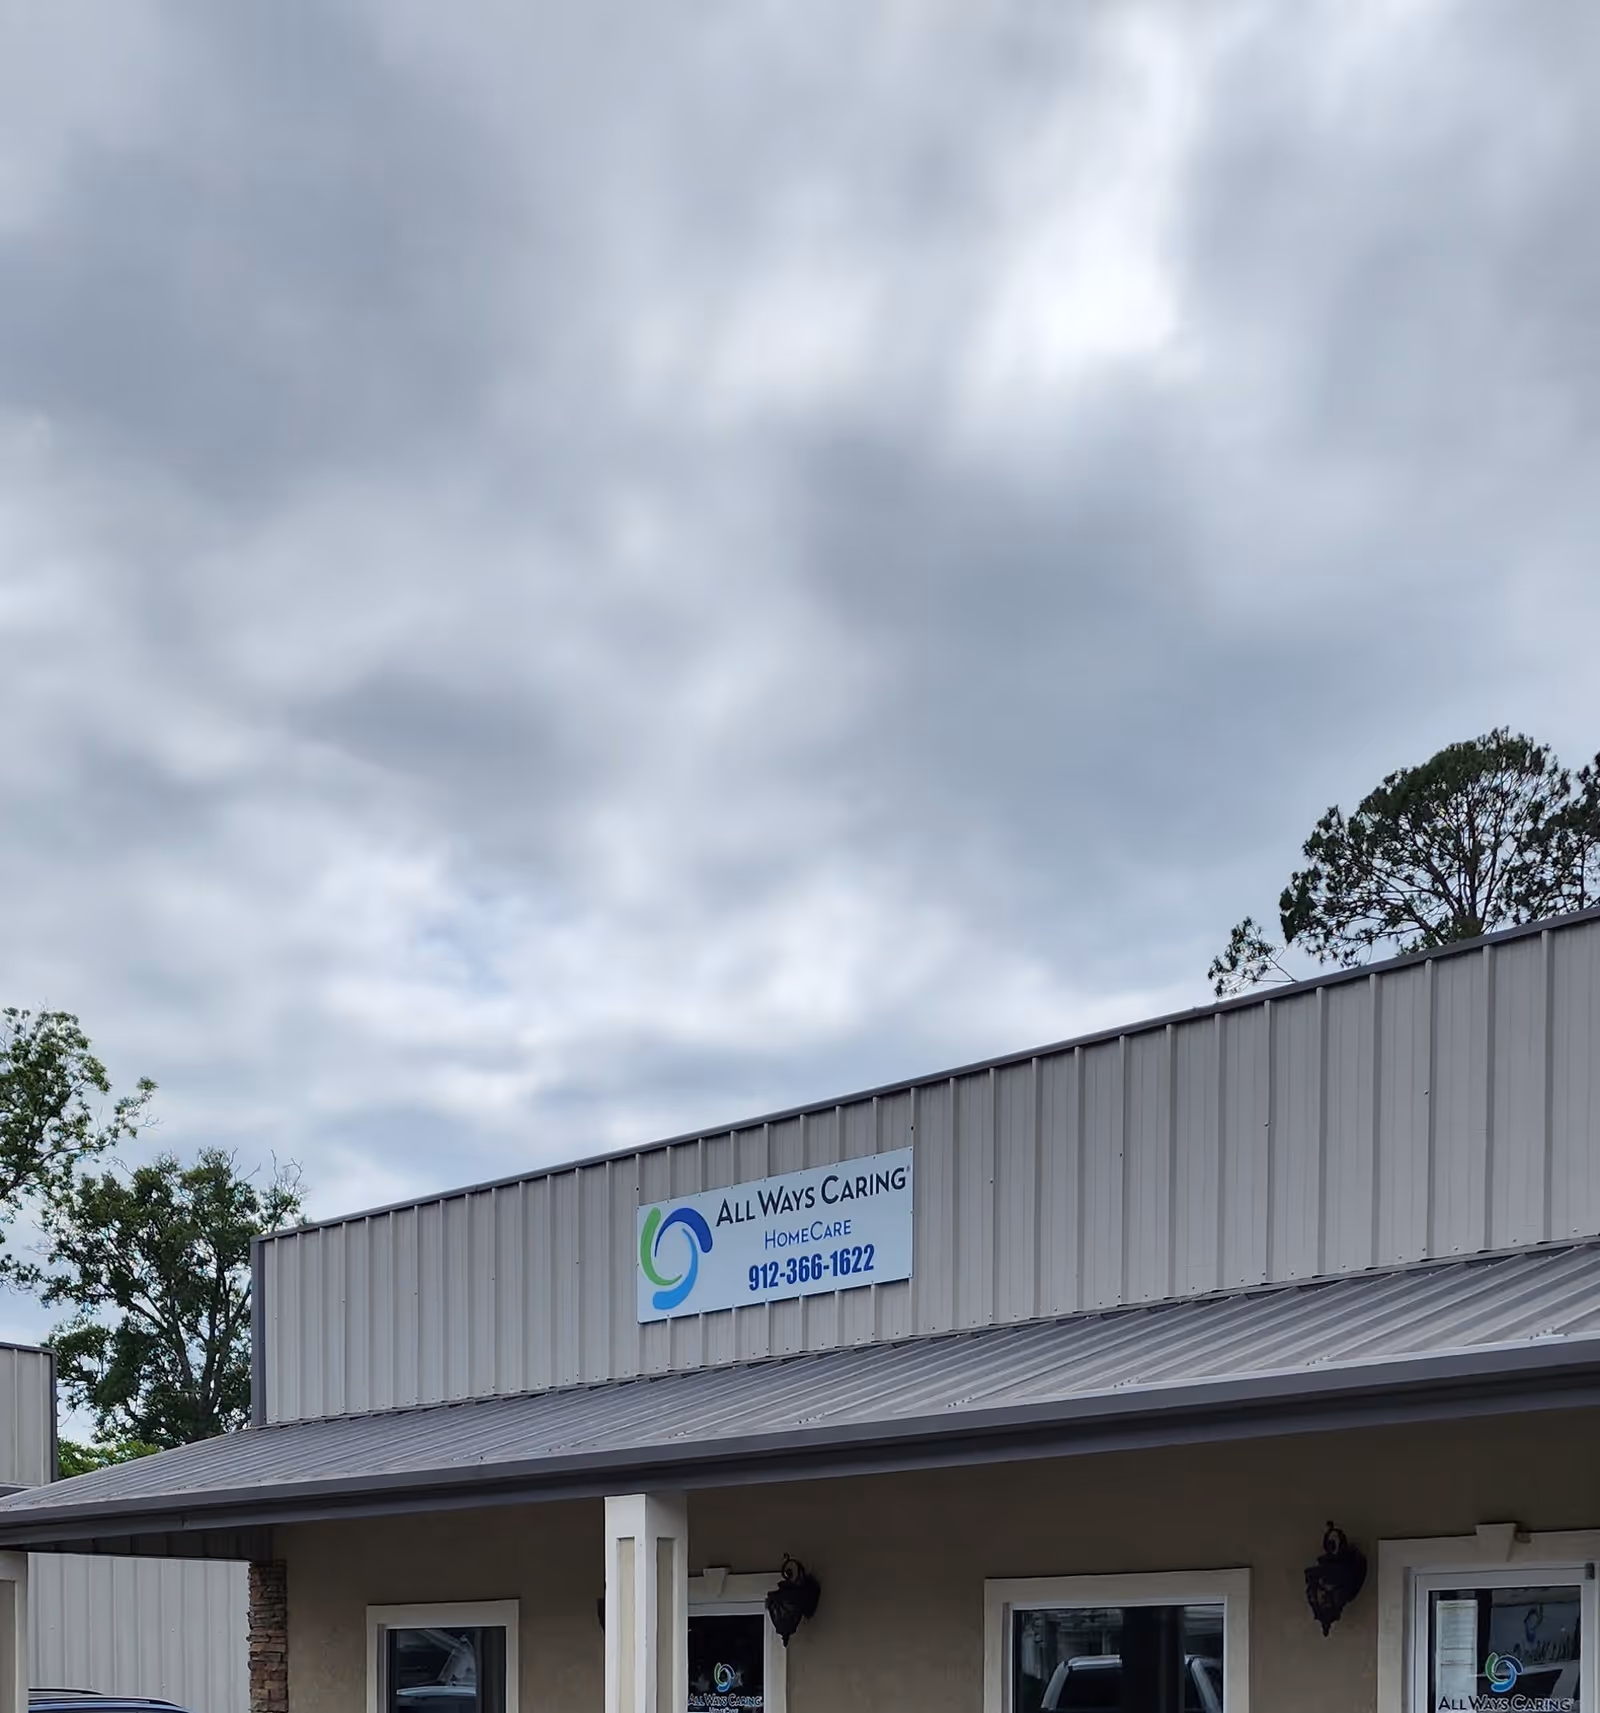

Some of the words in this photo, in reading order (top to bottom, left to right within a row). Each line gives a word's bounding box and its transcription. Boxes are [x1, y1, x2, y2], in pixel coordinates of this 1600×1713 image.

[716, 1199, 755, 1226] ALL
[757, 1185, 815, 1217] WAYS
[821, 1166, 907, 1205] CARING
[749, 1244, 875, 1291] 912-366-1622
[704, 1693, 727, 1706] WAYS
[1438, 1695, 1467, 1711] ALL
[1468, 1694, 1511, 1712] WAYS
[1512, 1693, 1571, 1712] CARING
